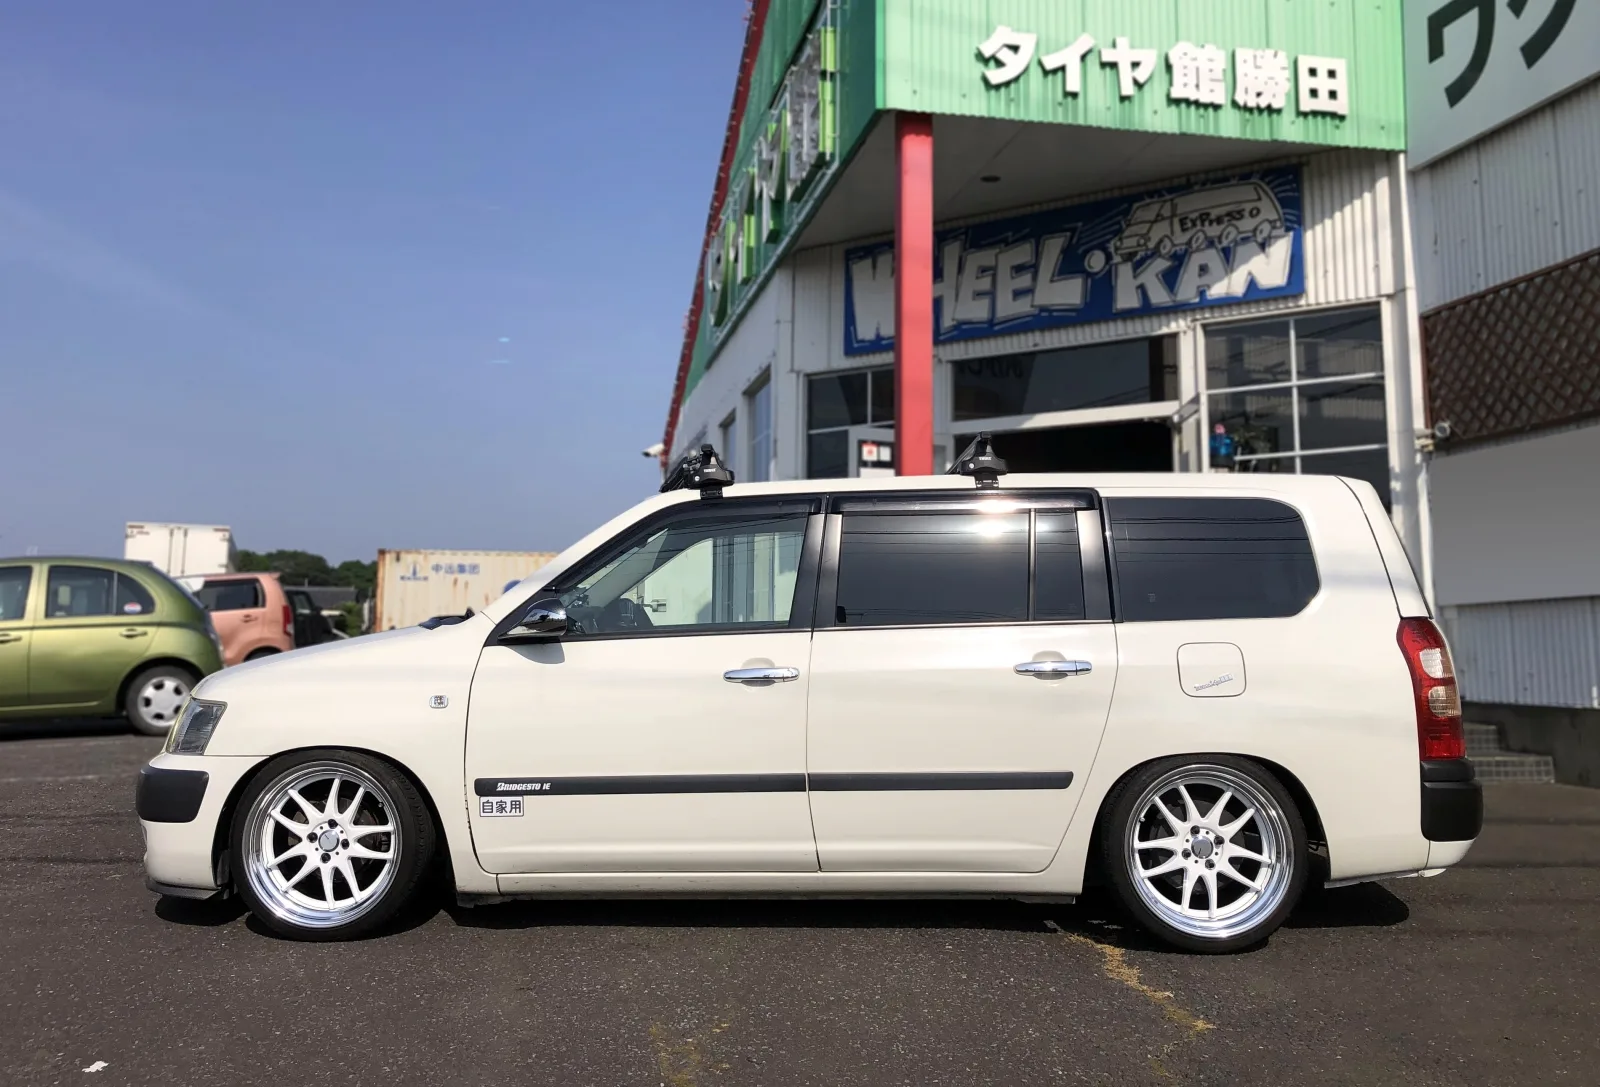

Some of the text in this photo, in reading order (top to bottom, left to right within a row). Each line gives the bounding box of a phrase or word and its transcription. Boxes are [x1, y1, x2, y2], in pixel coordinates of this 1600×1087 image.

[976, 25, 1347, 116] タイヤ館勝田
[1112, 230, 1294, 313] KAN
[482, 799, 522, 814] 自家用
